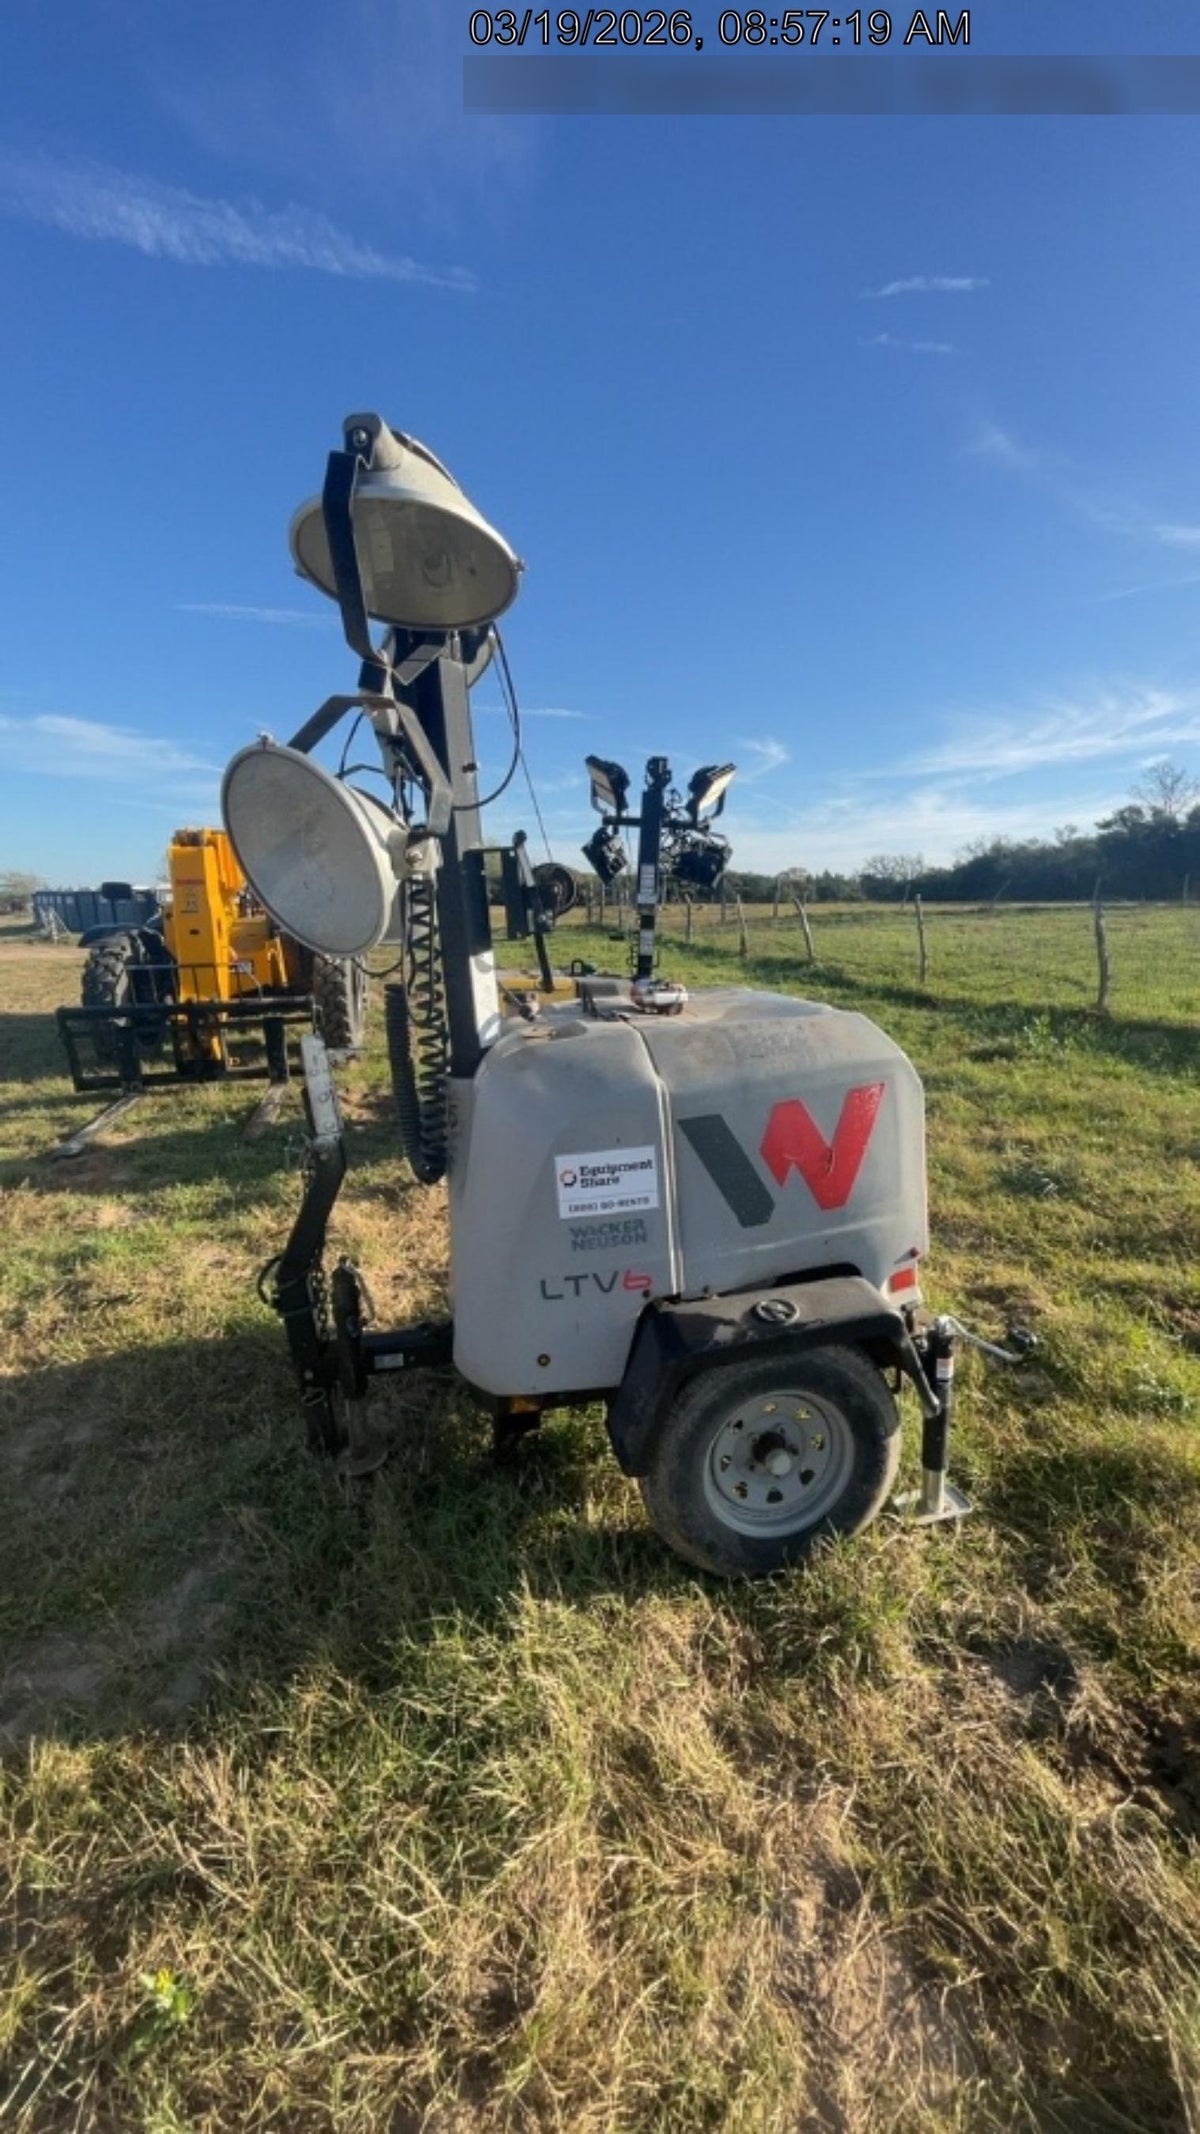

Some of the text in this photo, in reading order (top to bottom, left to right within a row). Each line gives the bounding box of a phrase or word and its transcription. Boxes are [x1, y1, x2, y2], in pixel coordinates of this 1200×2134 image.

[579, 1159, 653, 1177] Equipment
[580, 1176, 620, 1189] Share
[569, 1218, 645, 1239] WACKER
[571, 1232, 648, 1251] NEUSON
[540, 1268, 653, 1300] LTV6
